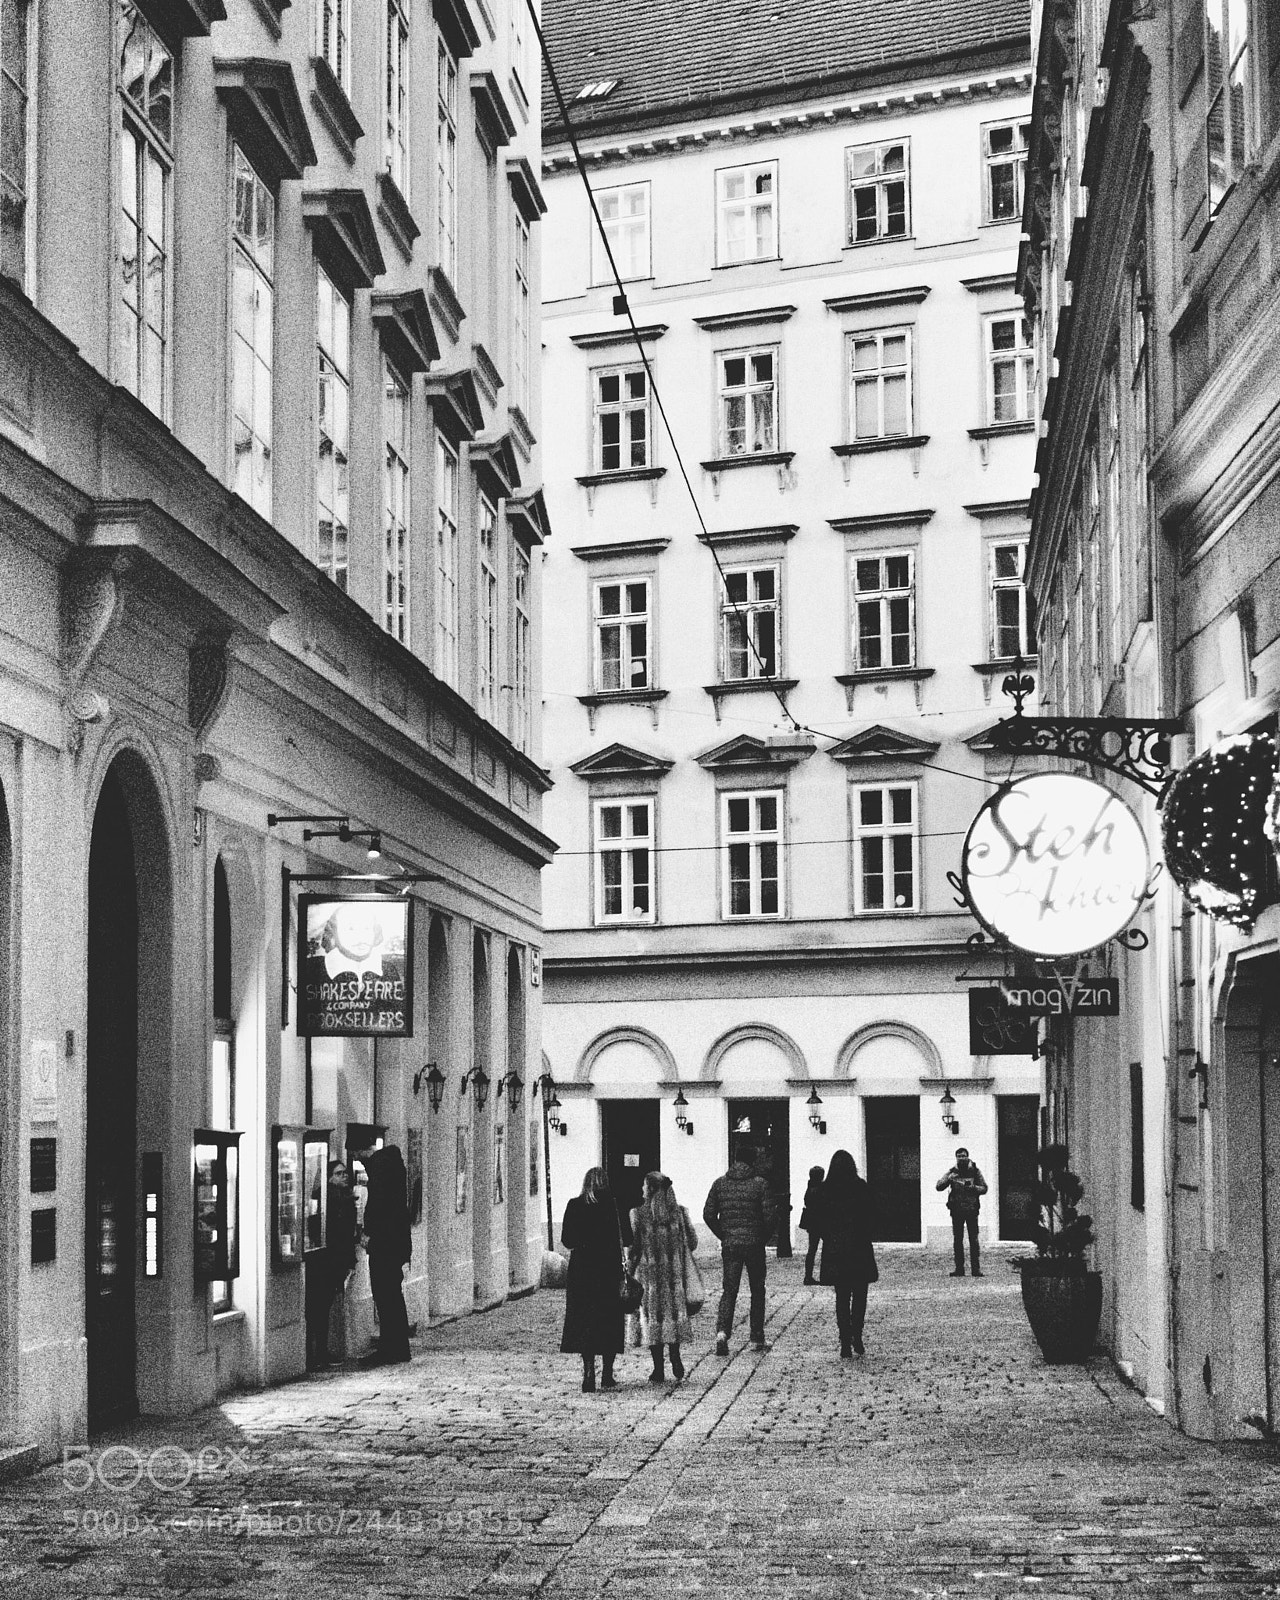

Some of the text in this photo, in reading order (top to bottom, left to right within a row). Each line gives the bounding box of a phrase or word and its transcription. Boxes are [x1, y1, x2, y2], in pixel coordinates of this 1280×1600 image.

[967, 790, 1117, 877] Steh
[306, 981, 404, 1000] SHAKESPEARE
[308, 1012, 404, 1028] OOKSELLERS
